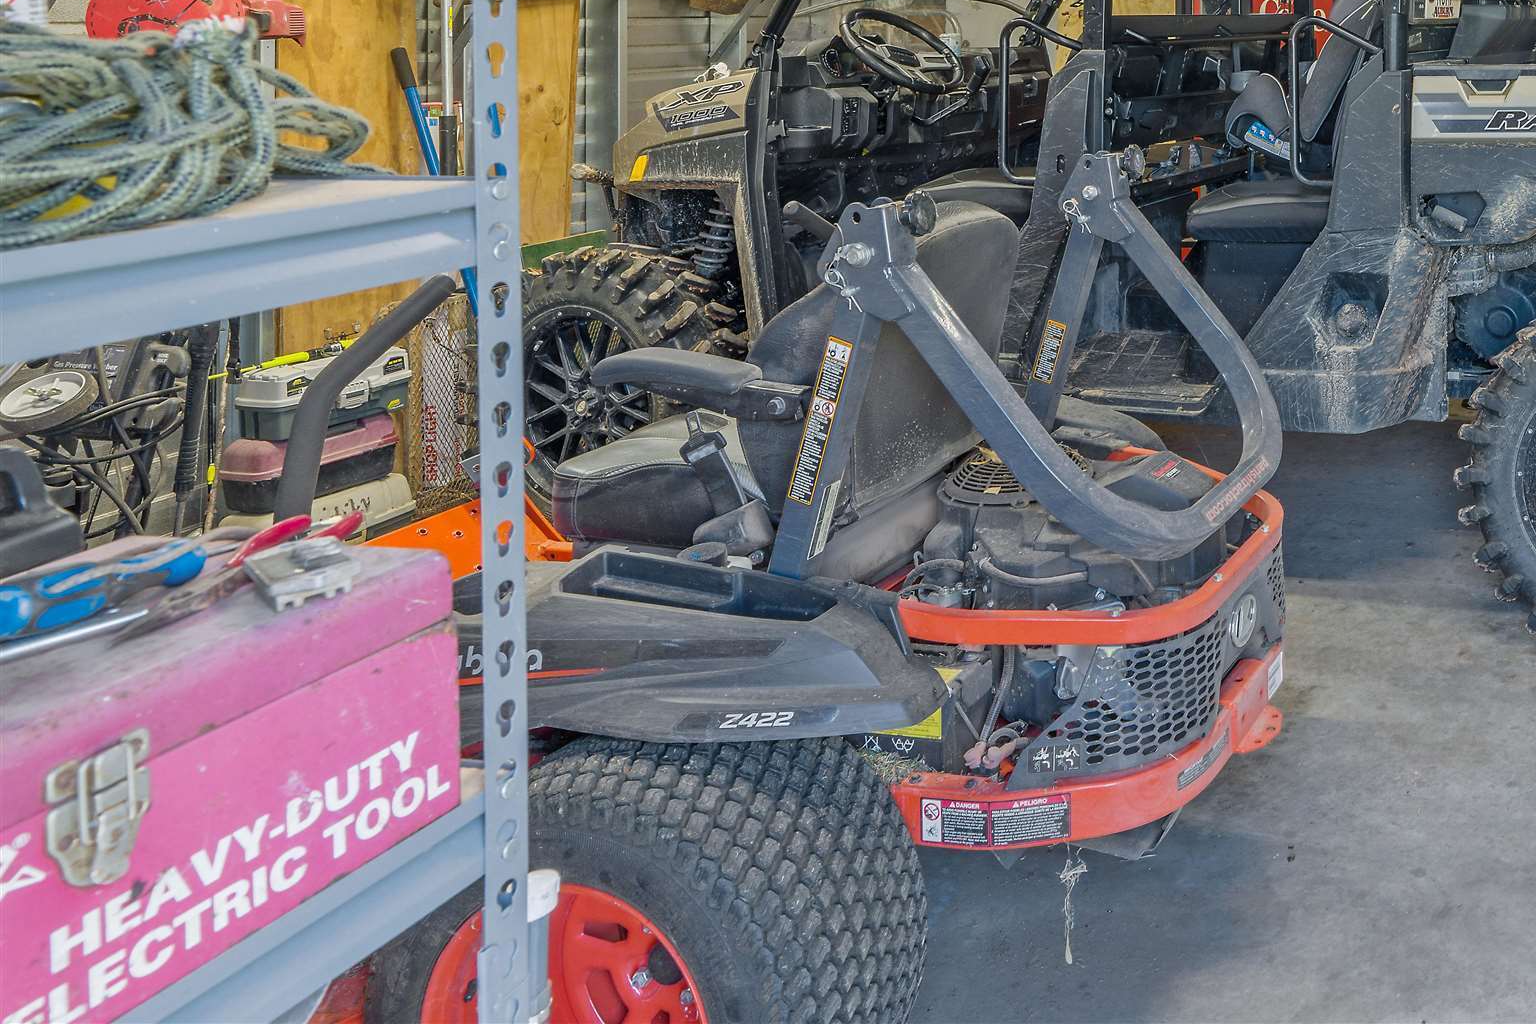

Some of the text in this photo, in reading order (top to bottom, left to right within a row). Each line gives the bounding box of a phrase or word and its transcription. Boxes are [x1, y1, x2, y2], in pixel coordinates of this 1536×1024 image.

[658, 80, 745, 112] XP
[671, 105, 729, 124] 1000
[719, 711, 795, 729] Z422
[323, 764, 450, 859] TOOL
[956, 801, 980, 810] DANGER
[1019, 798, 1048, 807] PELIGRO
[50, 730, 421, 974] HEAVY-DUTY
